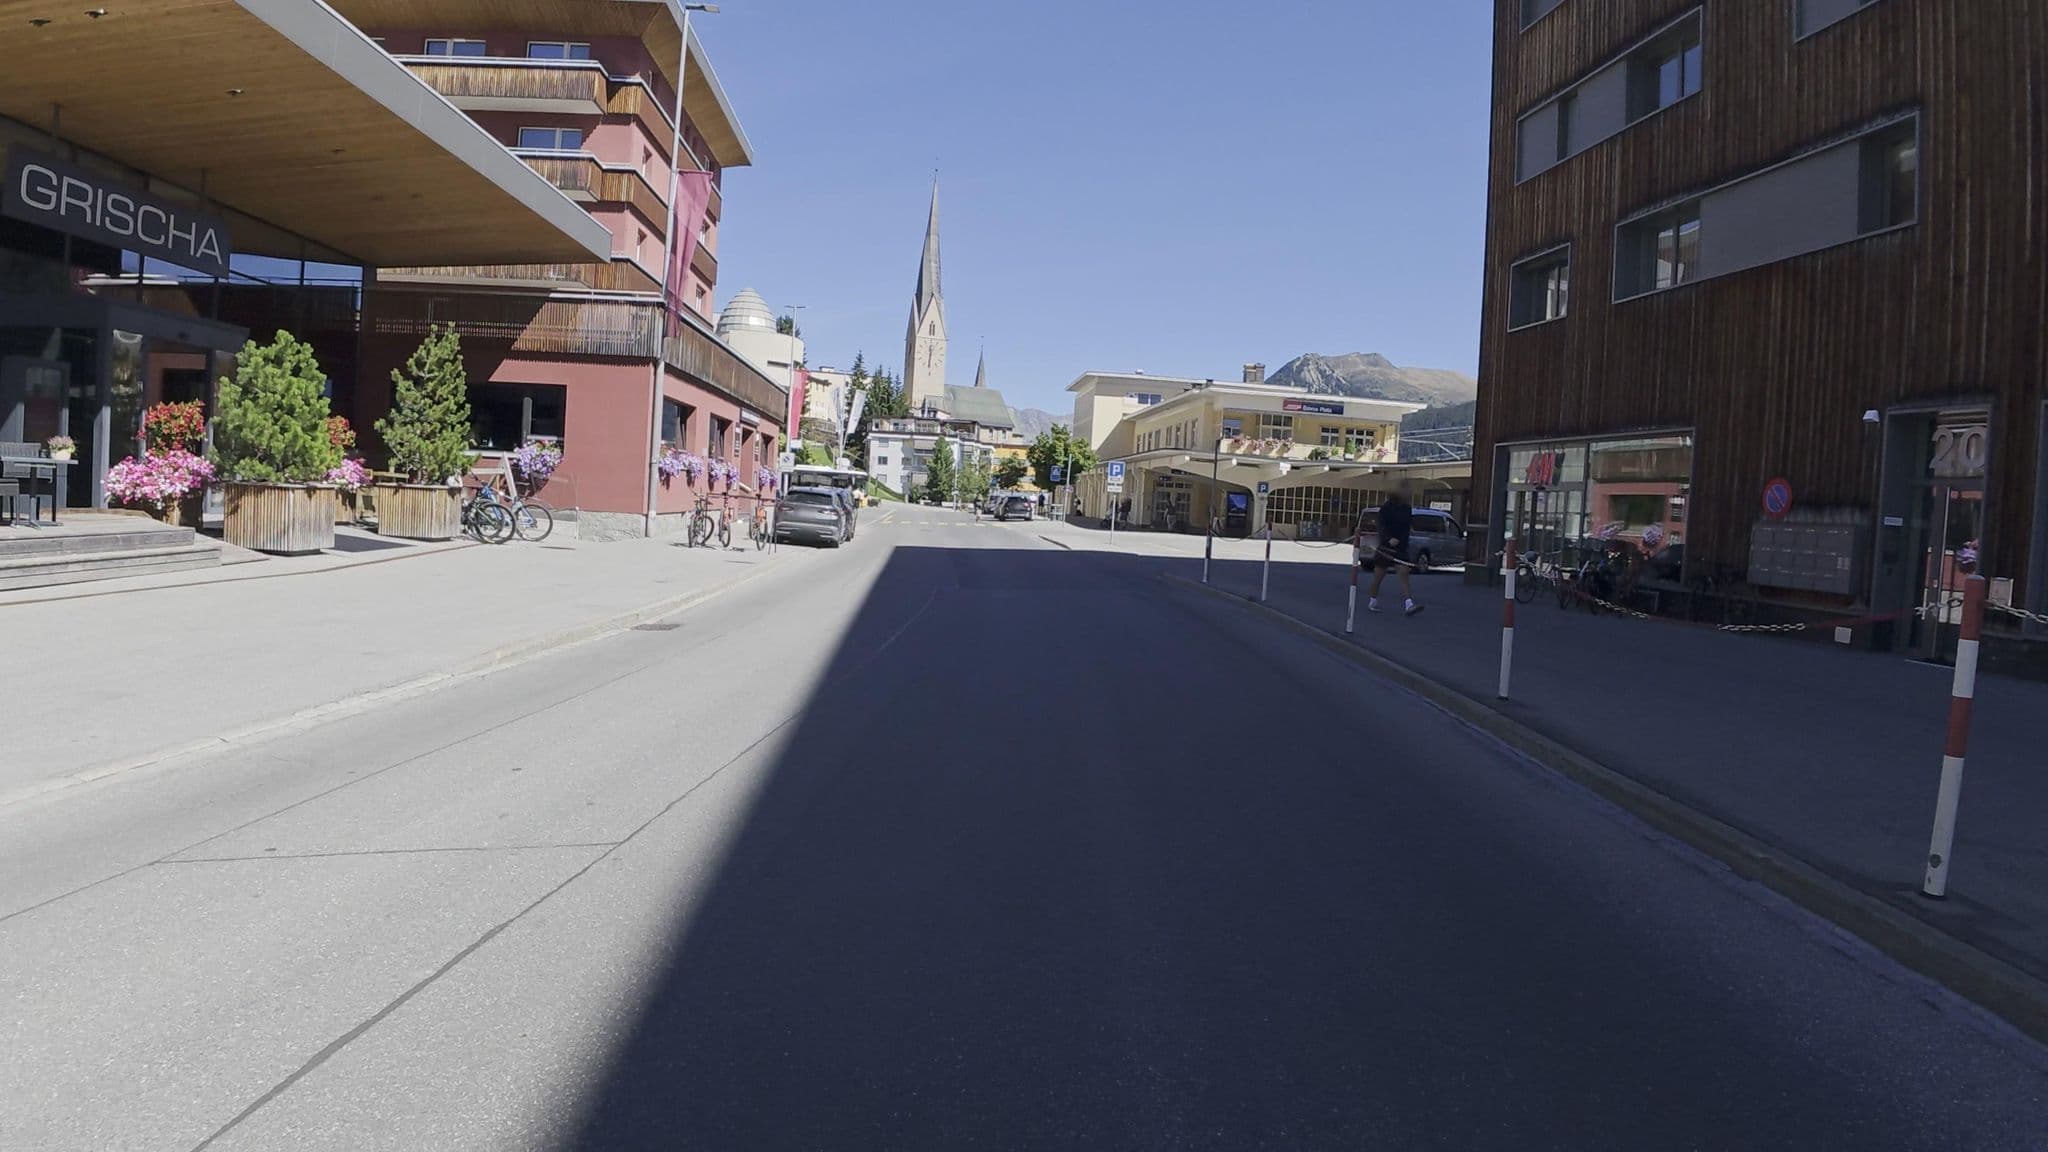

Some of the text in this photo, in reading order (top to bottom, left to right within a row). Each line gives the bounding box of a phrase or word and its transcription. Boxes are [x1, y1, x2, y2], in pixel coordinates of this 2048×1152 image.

[20, 164, 222, 265] GRISCHA
[1929, 426, 1986, 470] 20
[1112, 464, 1121, 476] P
[1260, 484, 1267, 492] P
